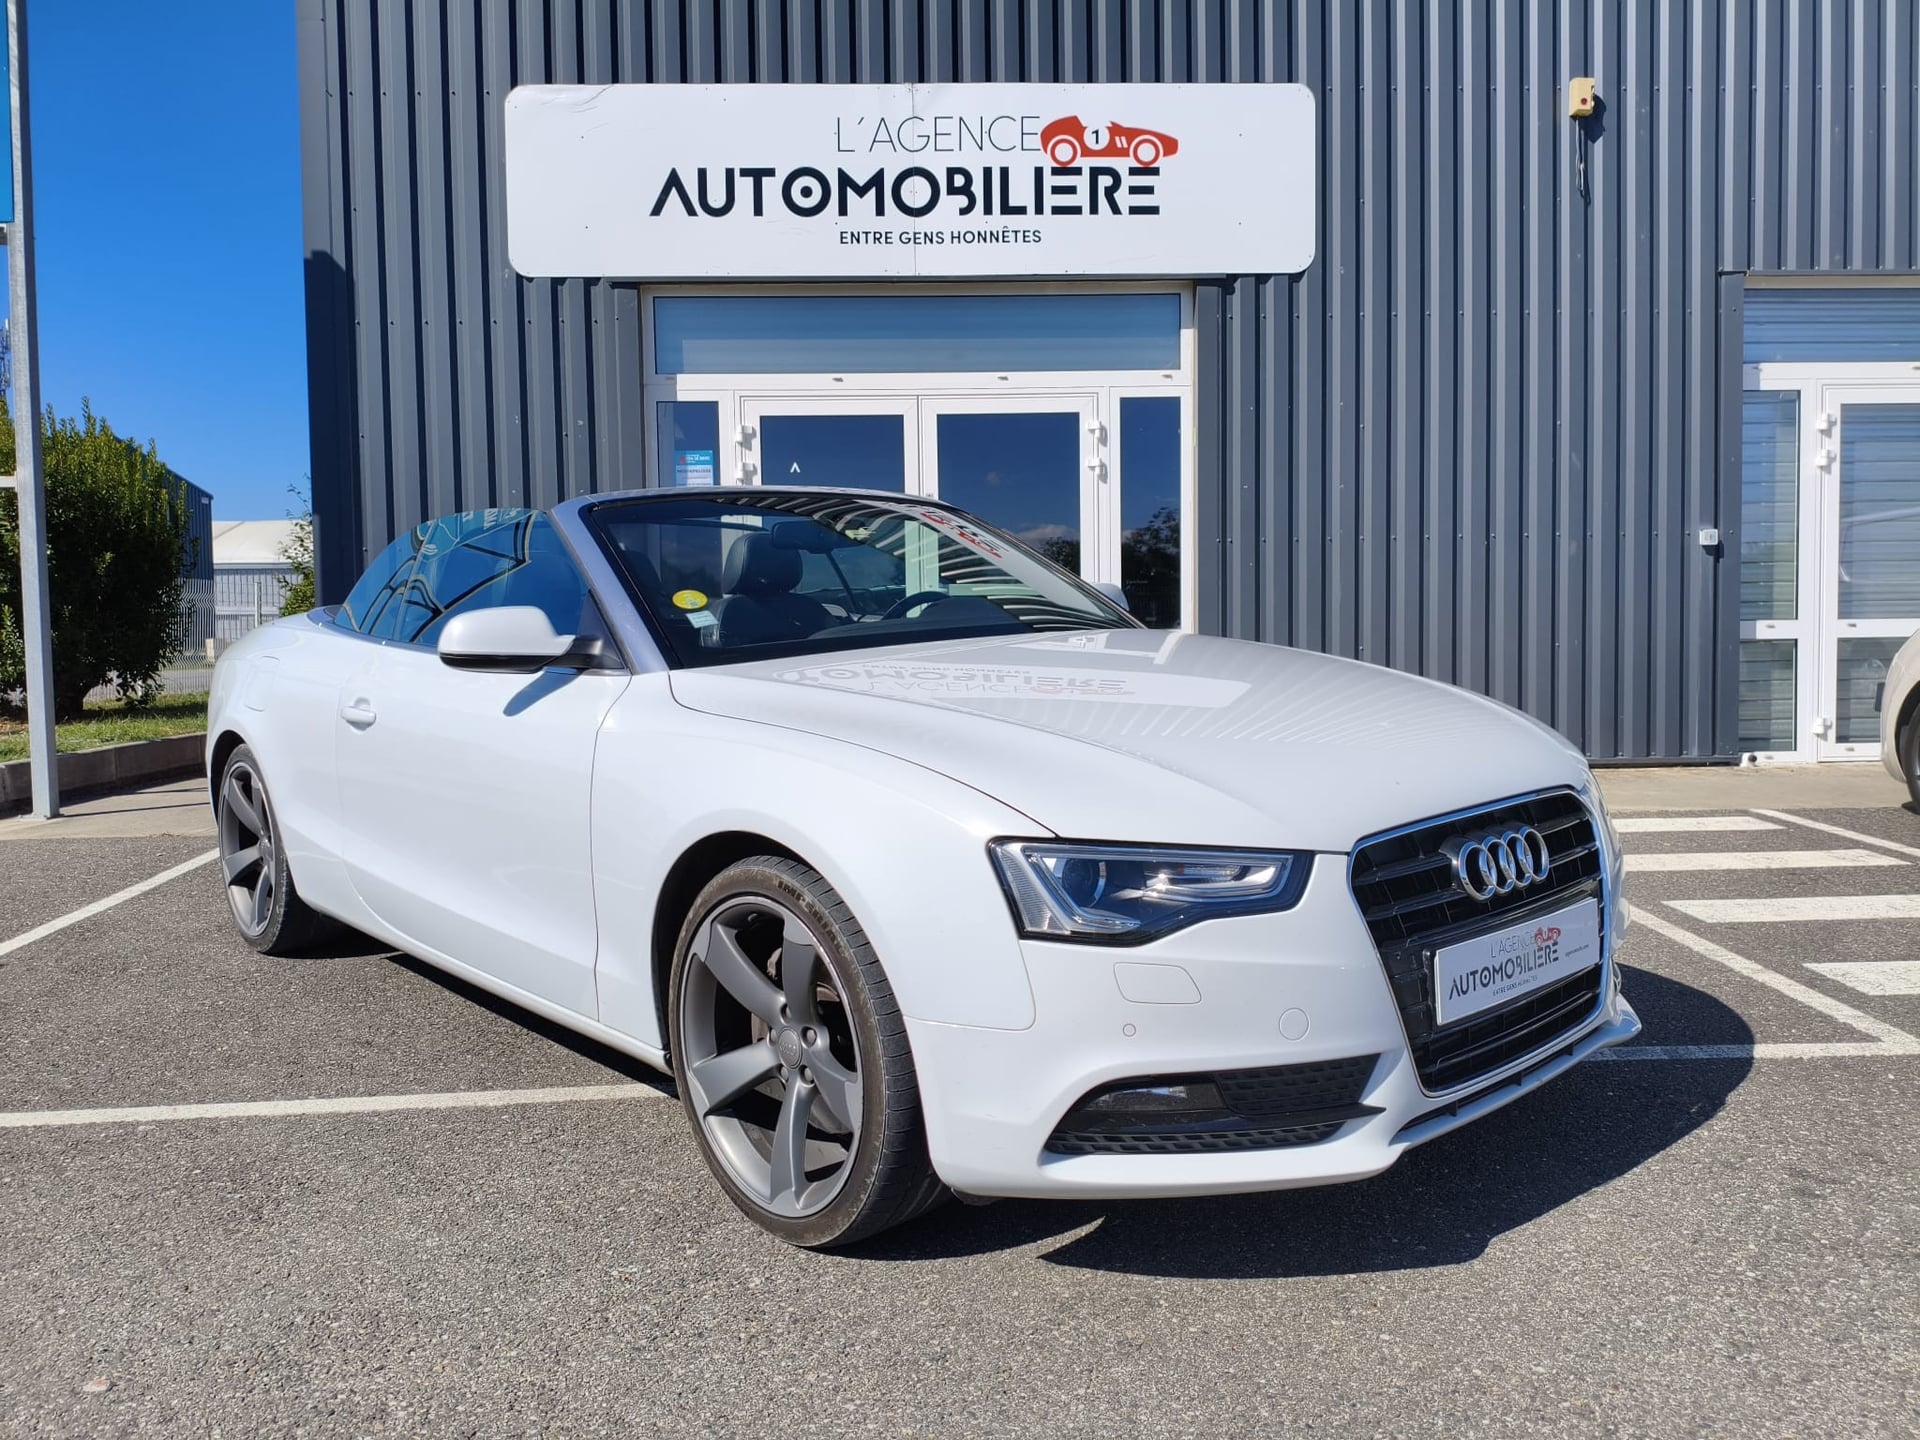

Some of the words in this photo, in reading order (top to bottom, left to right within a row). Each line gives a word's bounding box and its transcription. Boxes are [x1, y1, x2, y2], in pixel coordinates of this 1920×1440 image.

[837, 115, 1041, 153] L'AGENCE
[1091, 128, 1100, 145] 1
[839, 231, 894, 245] ENTRE
[898, 230, 946, 245] GENS
[950, 225, 1042, 244] HONNÊTES
